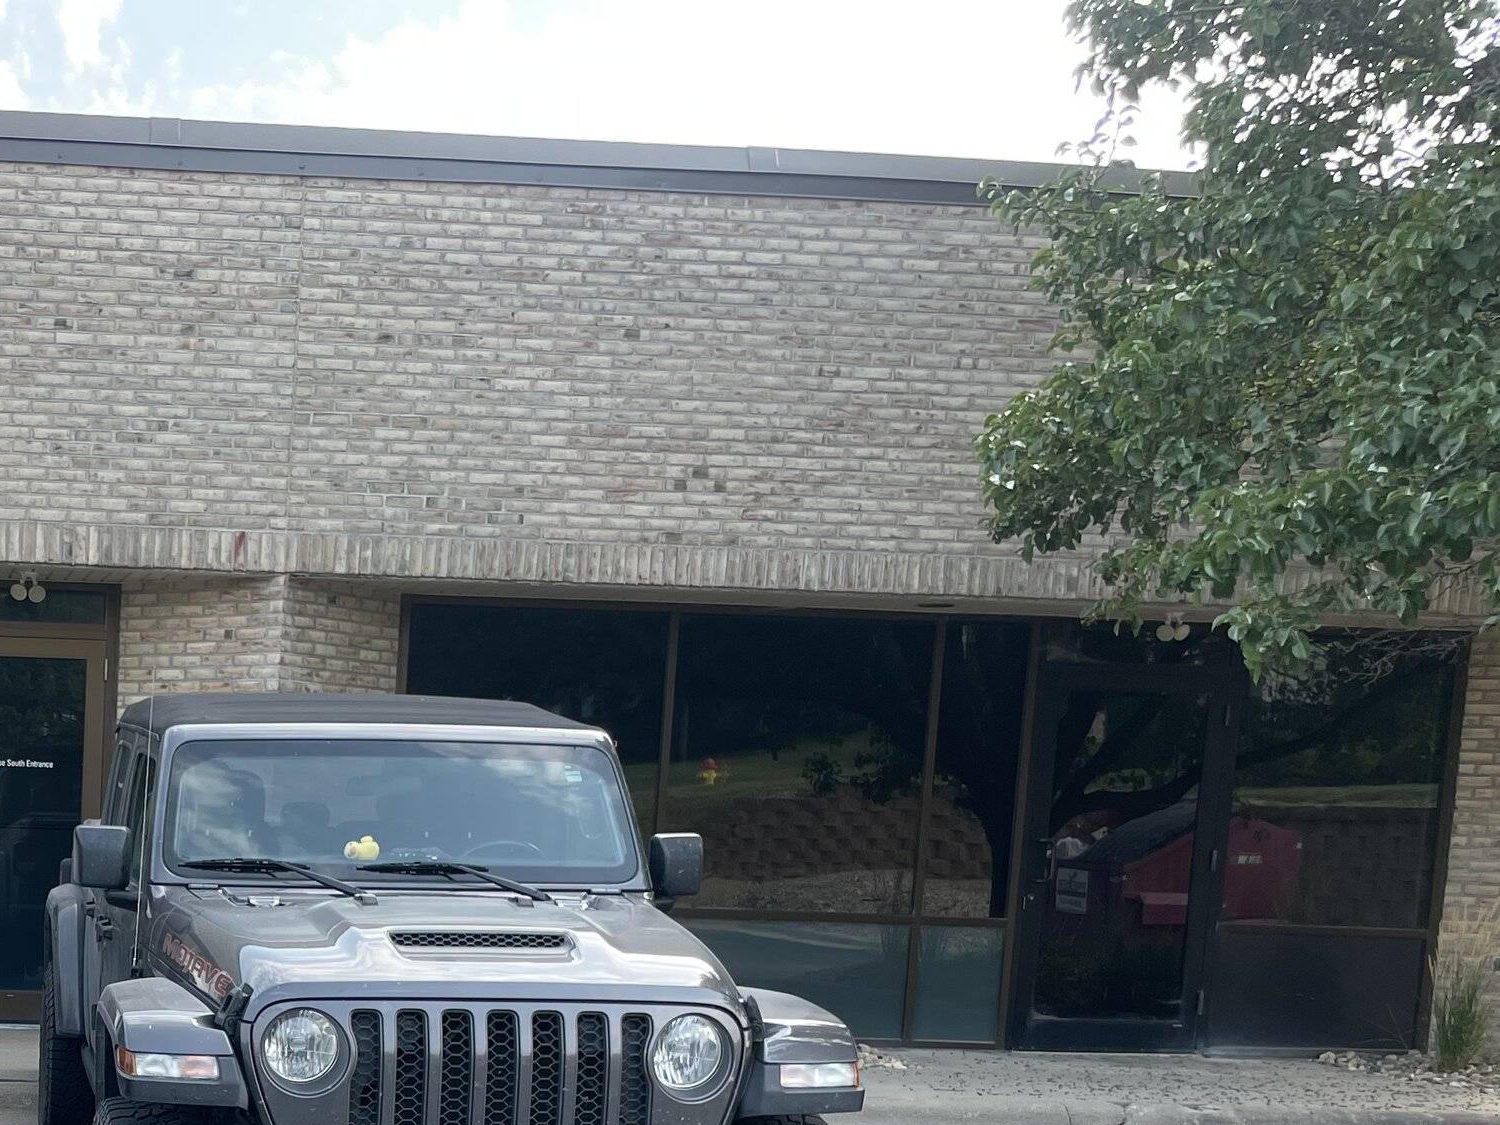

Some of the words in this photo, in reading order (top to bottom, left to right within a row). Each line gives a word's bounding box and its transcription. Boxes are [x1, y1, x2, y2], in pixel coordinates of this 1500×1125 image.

[7, 759, 25, 767] South
[26, 760, 54, 769] Entrance
[163, 932, 232, 998] MOJAVE
